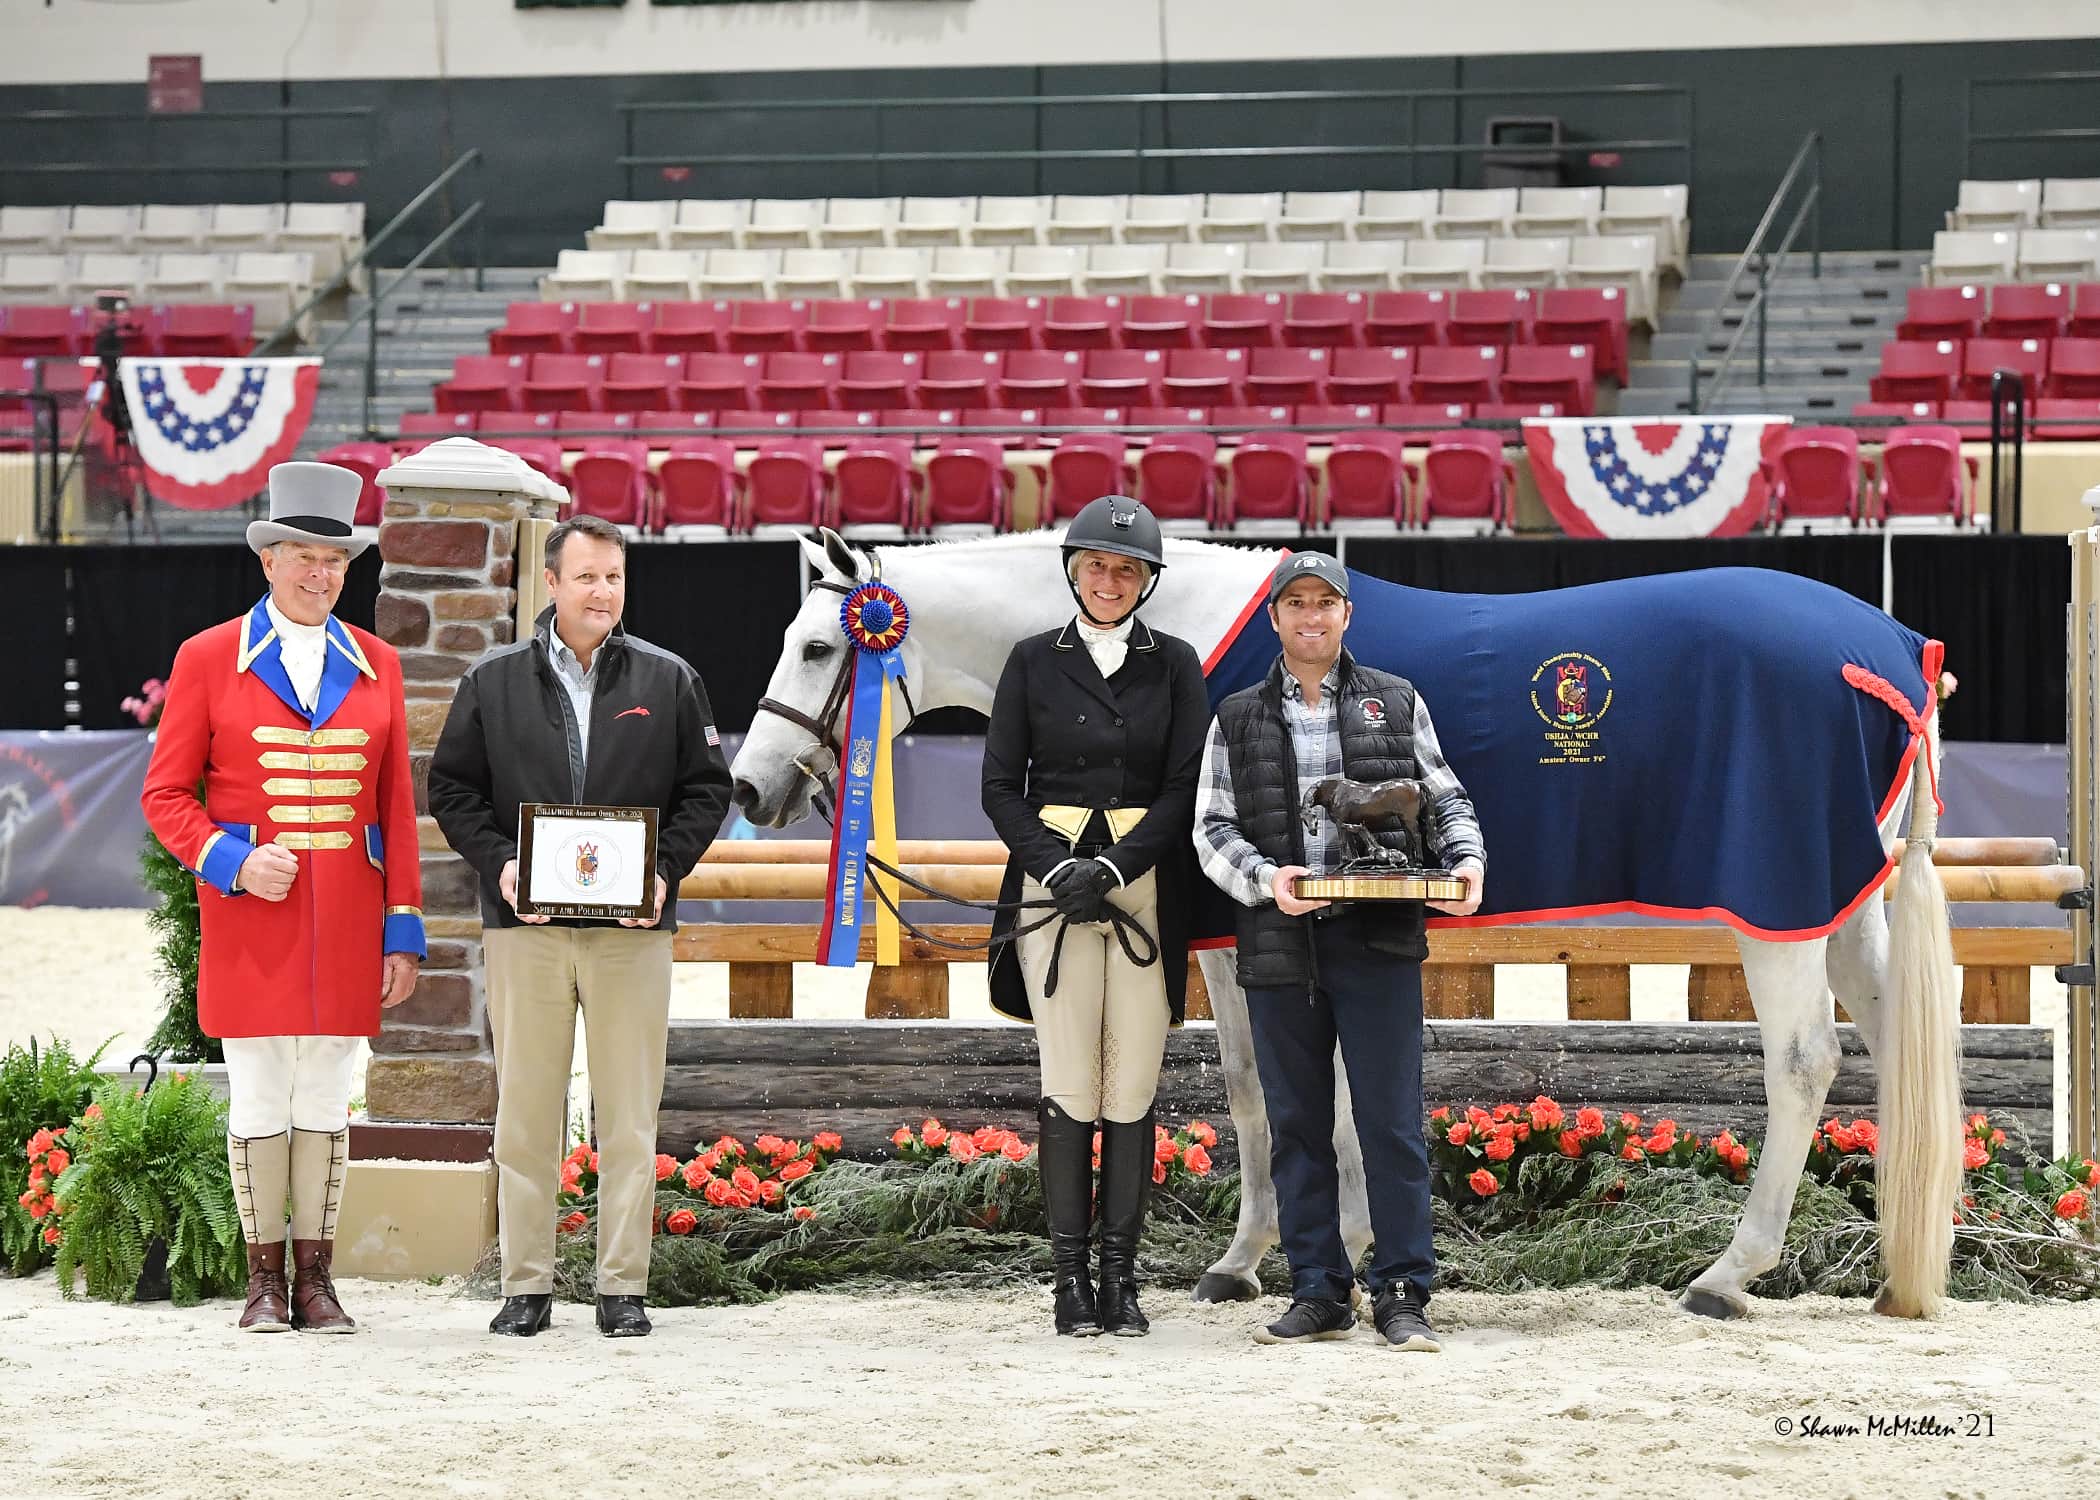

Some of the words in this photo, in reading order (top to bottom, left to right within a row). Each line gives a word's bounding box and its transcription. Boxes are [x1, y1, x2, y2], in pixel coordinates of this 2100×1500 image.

[1542, 651, 1582, 667] Championship
[1583, 653, 1603, 668] Hunter
[1530, 690, 1541, 710] United
[1552, 720, 1573, 731] Hunter
[1574, 718, 1596, 730] Jumper
[1544, 732, 1569, 740] USHJA
[1574, 732, 1600, 740] WCHR
[1553, 740, 1591, 748] NATIONAL
[1562, 748, 1581, 756] 2021
